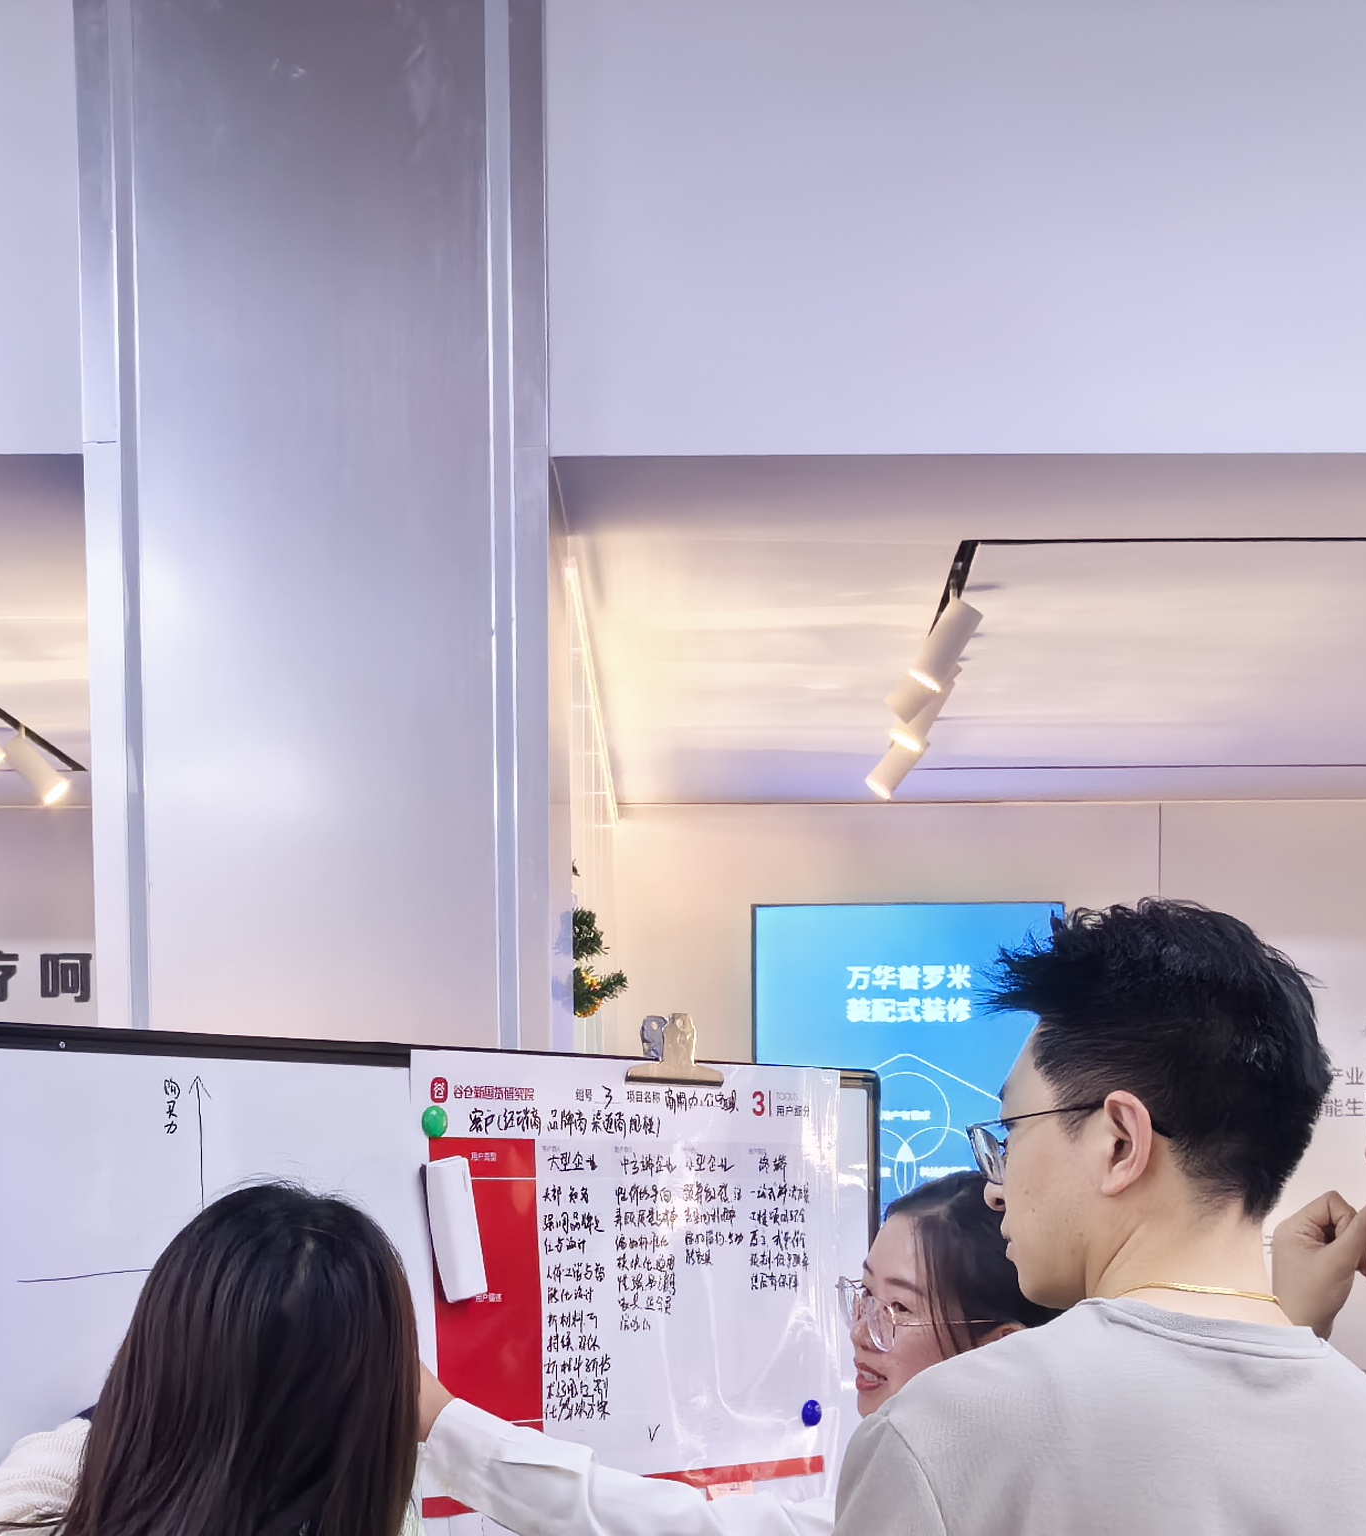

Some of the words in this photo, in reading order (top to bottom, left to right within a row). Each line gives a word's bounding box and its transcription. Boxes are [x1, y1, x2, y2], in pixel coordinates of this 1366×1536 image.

[40, 953, 92, 1003] 呵
[846, 965, 971, 990] 万华普罗米
[846, 998, 971, 1023] 装配式装修
[575, 1088, 592, 1101] 组号
[626, 1091, 661, 1103] 项目名称
[752, 1090, 766, 1117] 3
[776, 1105, 810, 1117] 用户细分
